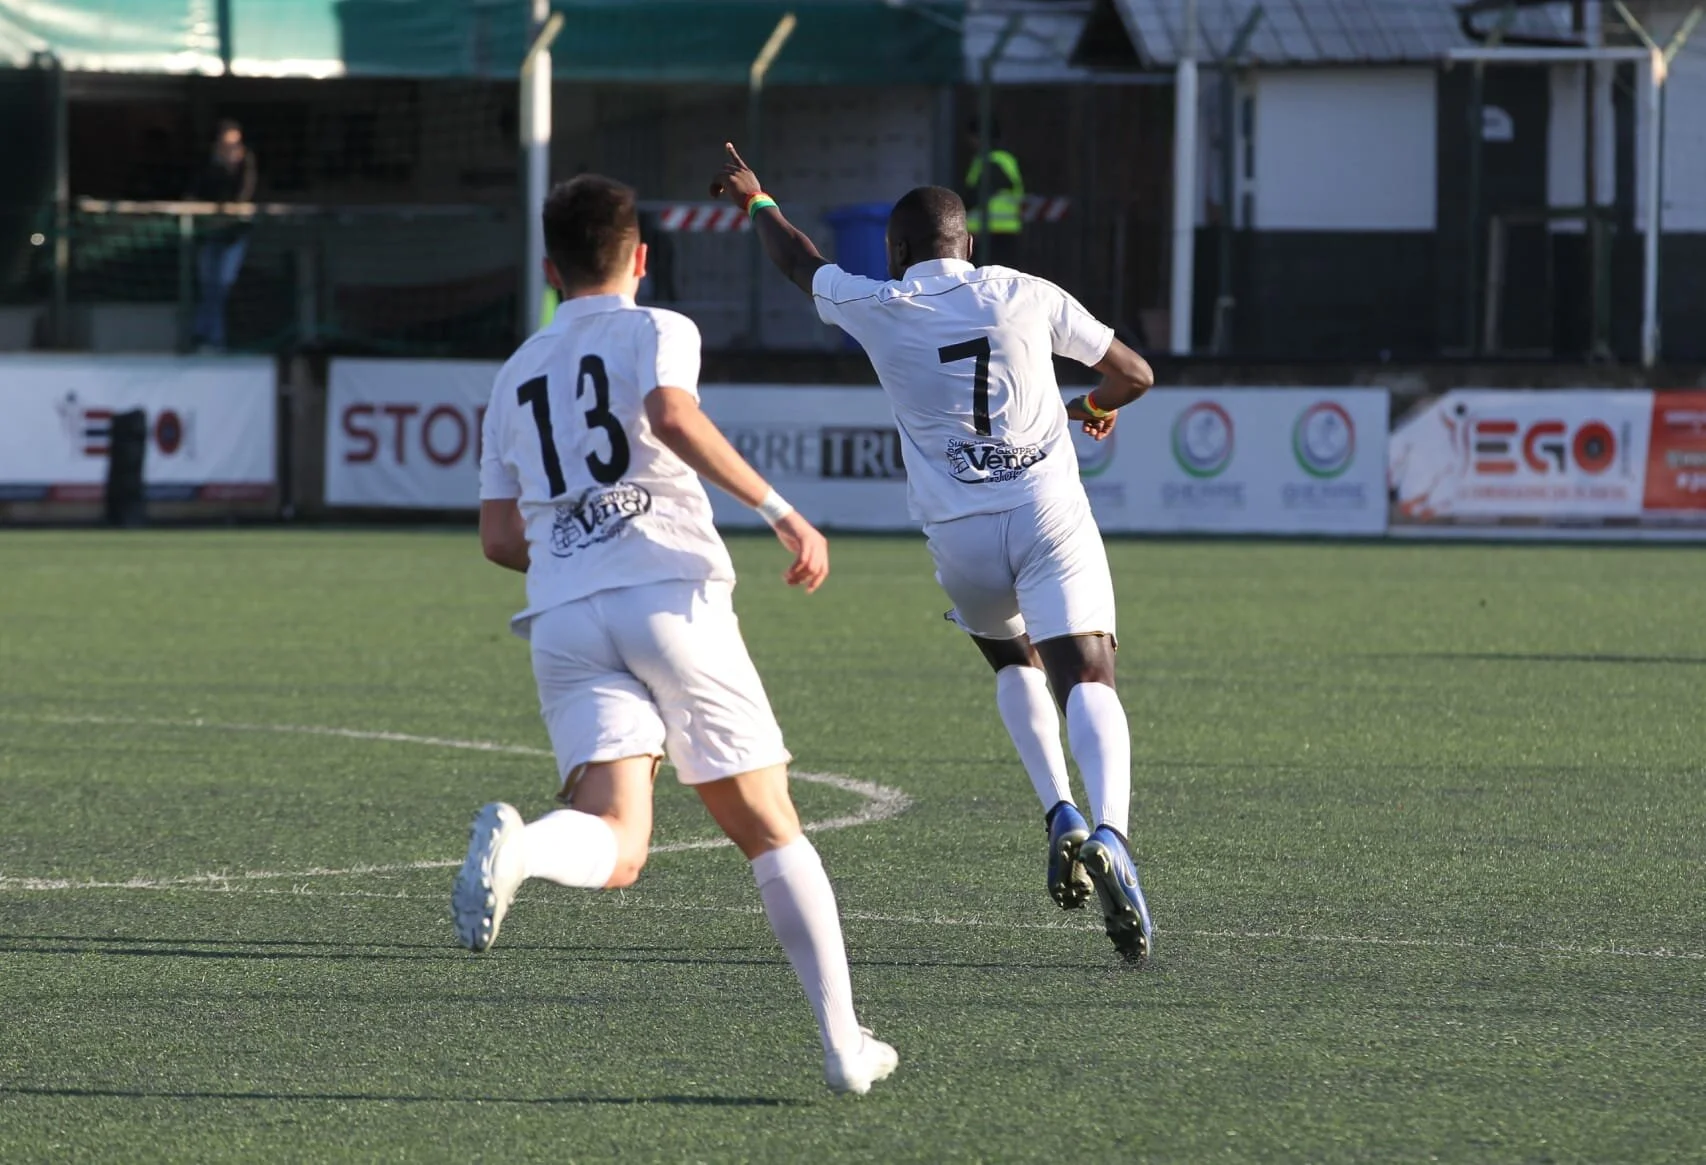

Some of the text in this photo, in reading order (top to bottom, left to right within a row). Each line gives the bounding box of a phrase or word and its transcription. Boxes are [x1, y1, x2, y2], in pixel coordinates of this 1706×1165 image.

[938, 336, 992, 436] 7
[83, 408, 182, 458] EO
[343, 403, 486, 467] STO
[517, 354, 630, 499] 13
[1474, 420, 1616, 475] EGO
[963, 446, 1037, 471] Vena
